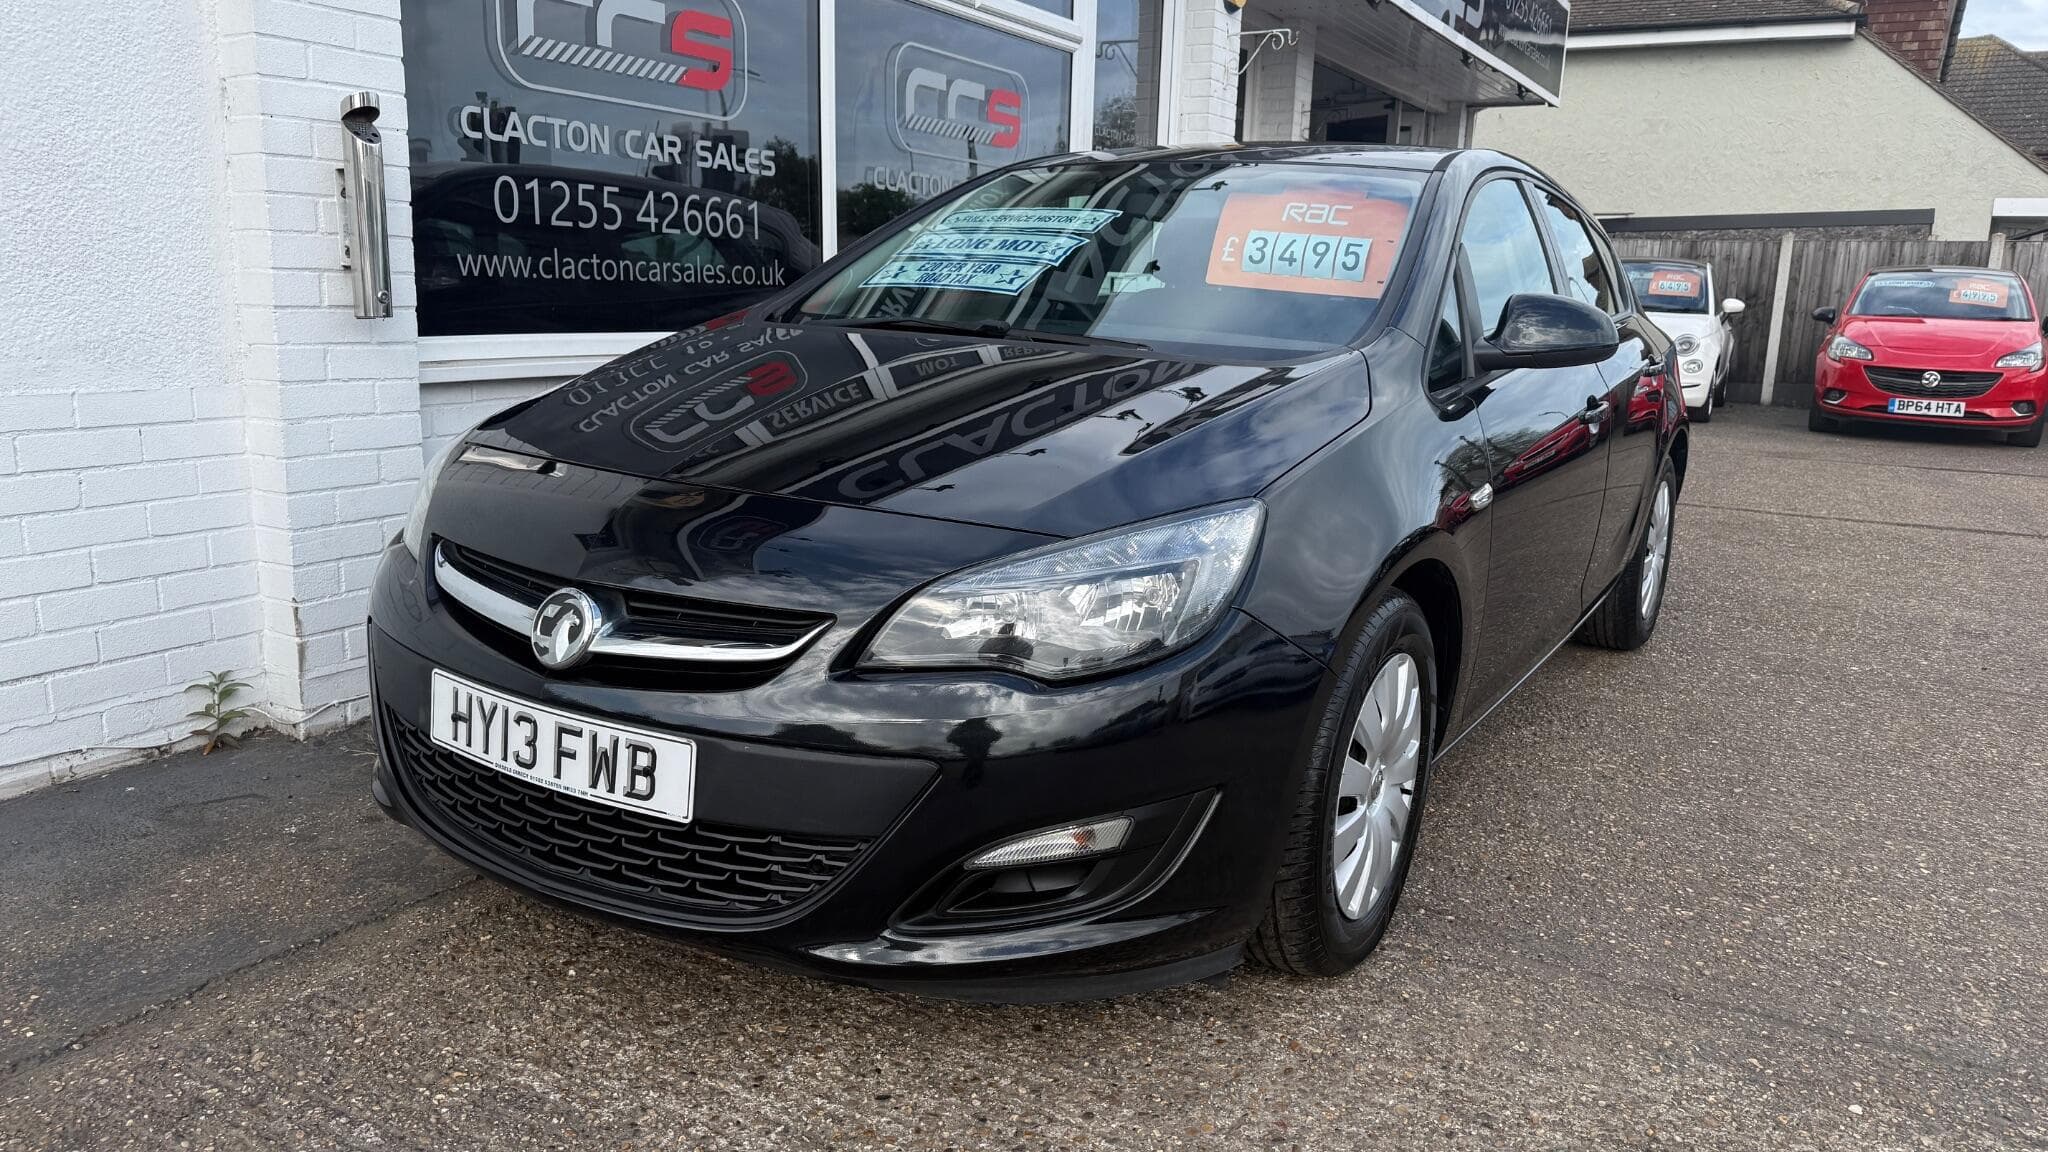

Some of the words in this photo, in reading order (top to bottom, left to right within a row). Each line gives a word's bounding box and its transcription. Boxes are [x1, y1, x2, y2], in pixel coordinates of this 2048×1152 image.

[905, 67, 1022, 149] CCS
[460, 105, 610, 155] CLACTON
[624, 128, 682, 165] CAR
[696, 140, 777, 177] SALES
[873, 166, 953, 195] CLACTON
[493, 175, 622, 231] 01255
[636, 192, 760, 241] 426661
[987, 215, 1033, 223] SERVICE
[1032, 215, 1080, 224] HISTORY
[931, 238, 993, 250] LONG
[993, 239, 1043, 251] MOT
[1247, 236, 1364, 272] 3495
[456, 247, 786, 287] www.clactoncarsales.co.uk
[915, 272, 950, 283] ROAD
[950, 273, 978, 285] TAX
[943, 262, 966, 273] PER
[967, 263, 1002, 275] YEAR
[1897, 399, 1932, 413] BP64
[1935, 401, 1962, 415] HTA
[451, 686, 538, 770] HY13
[553, 720, 658, 802] FWB
